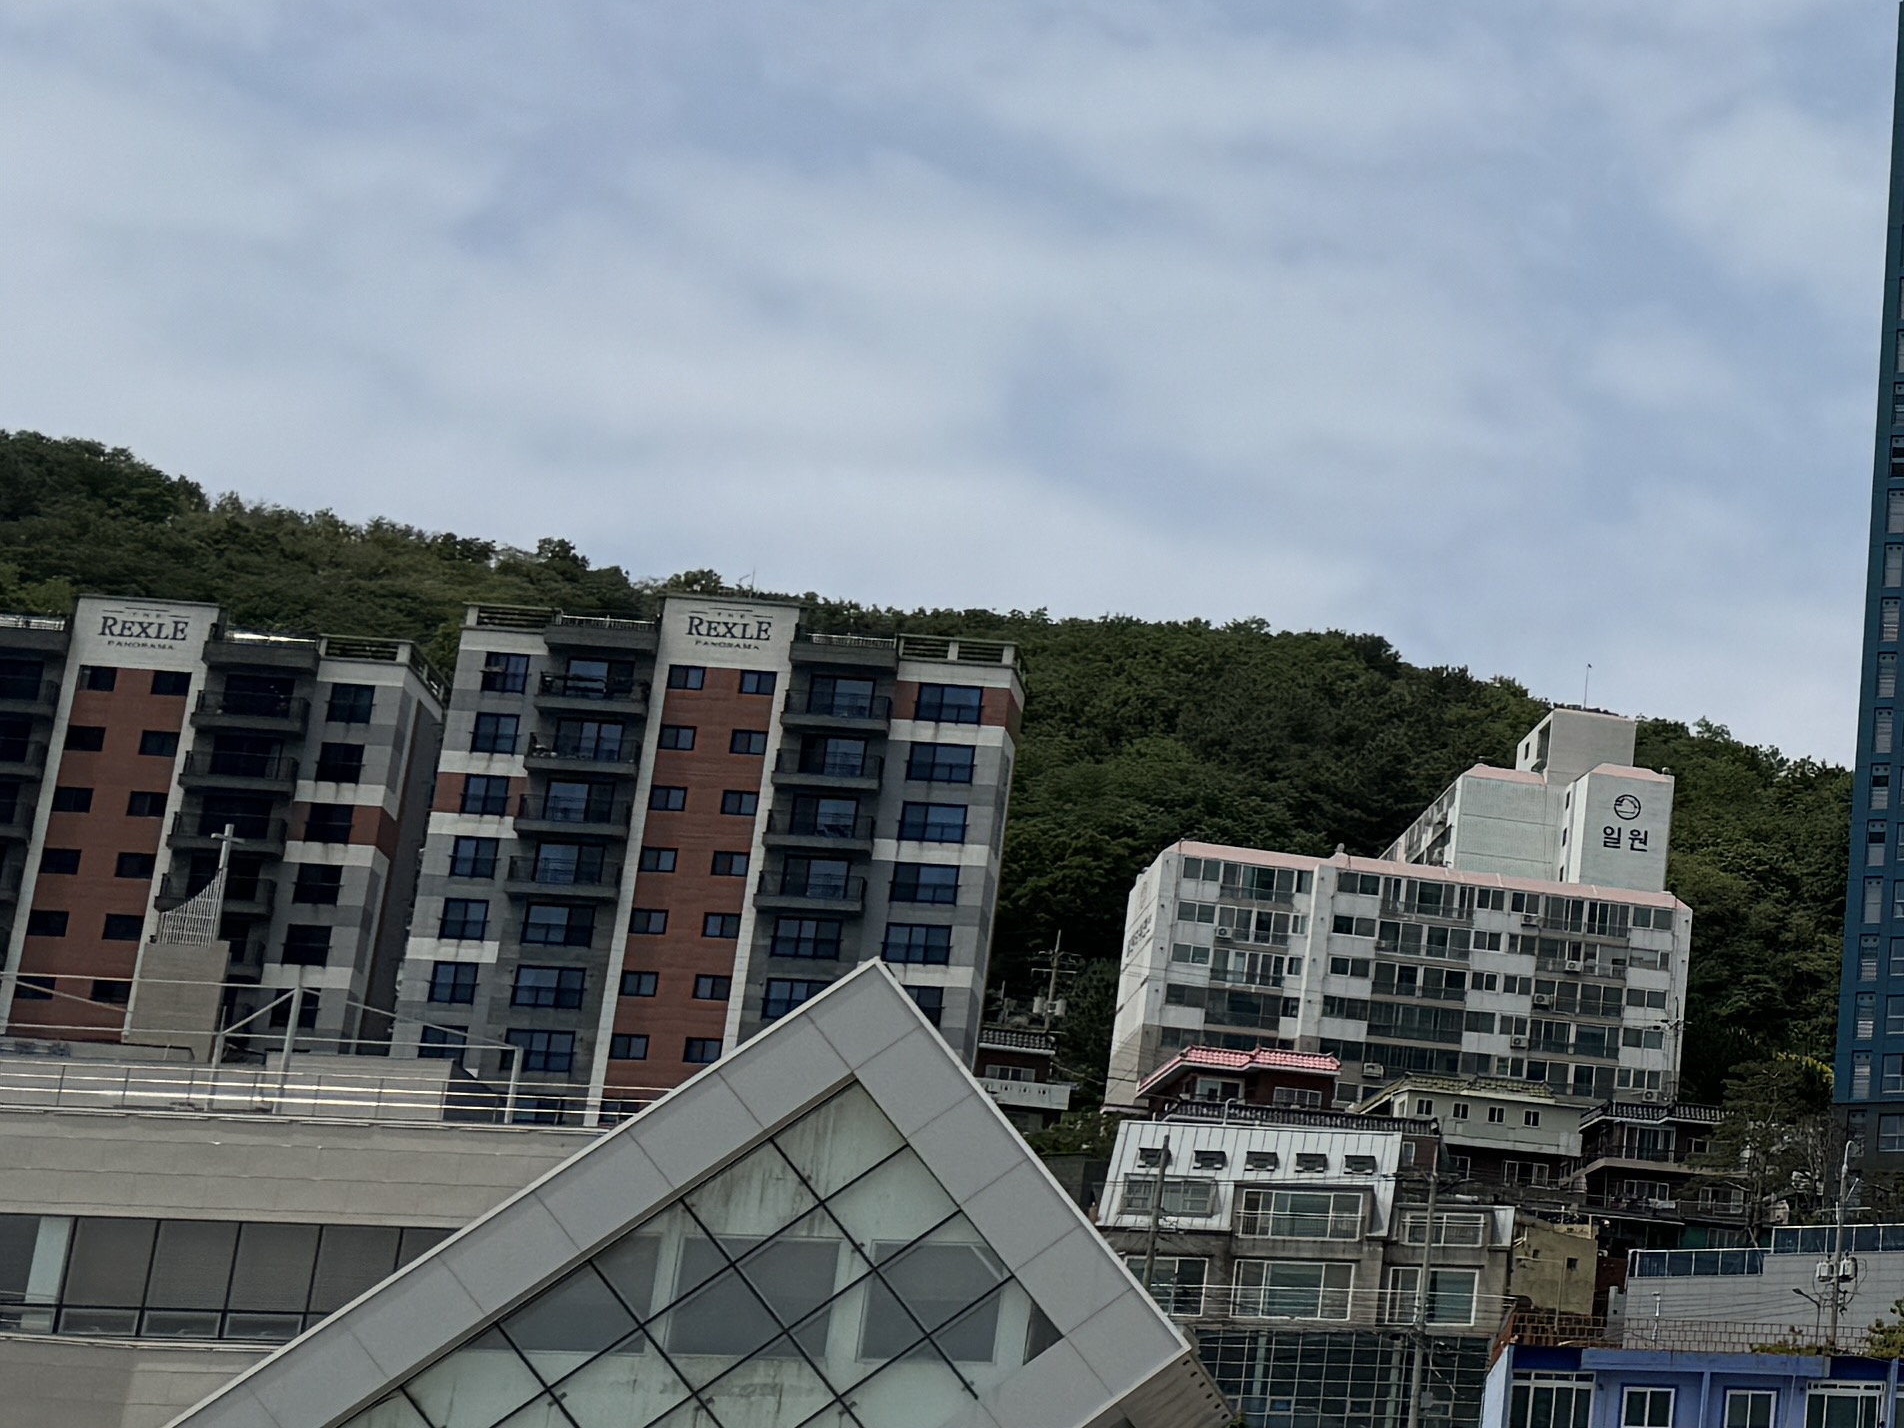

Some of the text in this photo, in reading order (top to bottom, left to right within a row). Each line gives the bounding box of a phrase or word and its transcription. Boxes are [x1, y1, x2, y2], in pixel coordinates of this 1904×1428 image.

[98, 615, 189, 641] REXLE
[685, 615, 772, 641] REXLE
[107, 640, 175, 650] PANORAMA
[694, 639, 760, 650] PANORAMA
[1603, 825, 1648, 852] 일원
